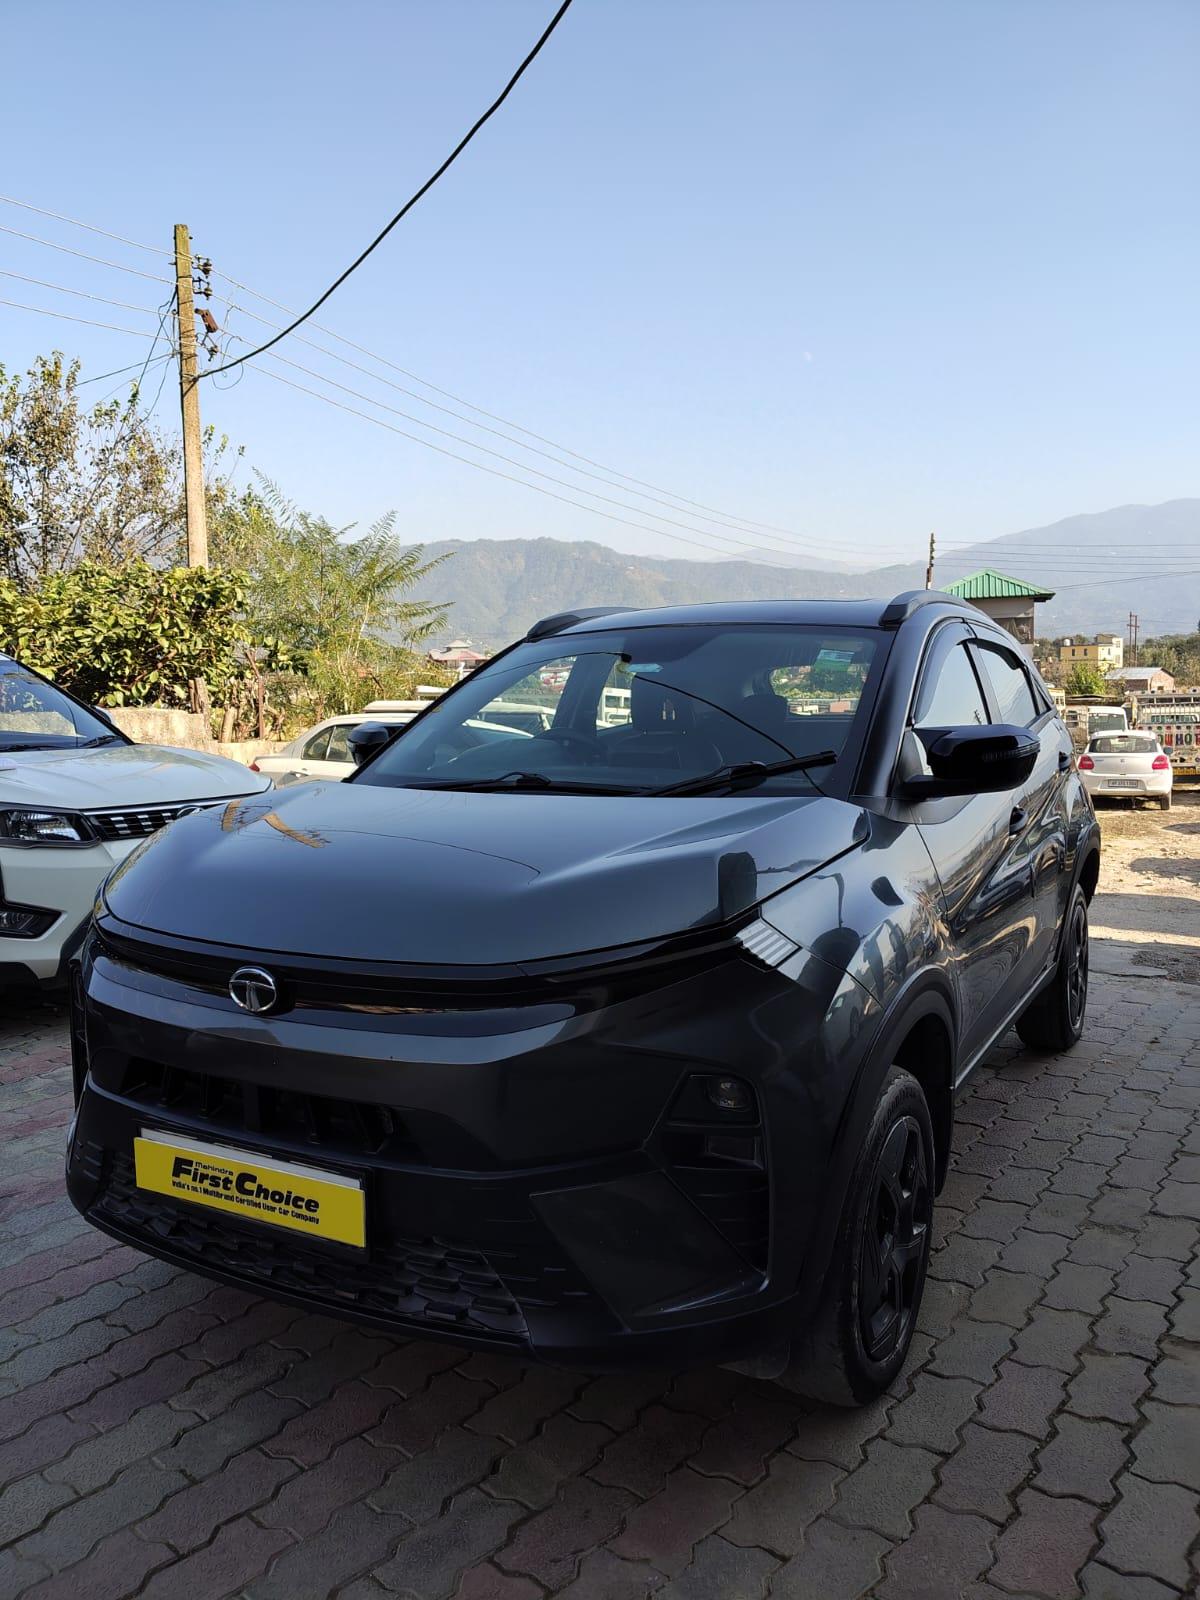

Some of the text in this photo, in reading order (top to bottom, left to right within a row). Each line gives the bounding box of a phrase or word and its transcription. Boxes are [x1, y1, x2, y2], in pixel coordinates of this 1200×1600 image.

[172, 1156, 320, 1213] First Choice
[235, 1195, 262, 1209] Certified
[278, 1206, 290, 1216] Car
[291, 1210, 320, 1225] Company
